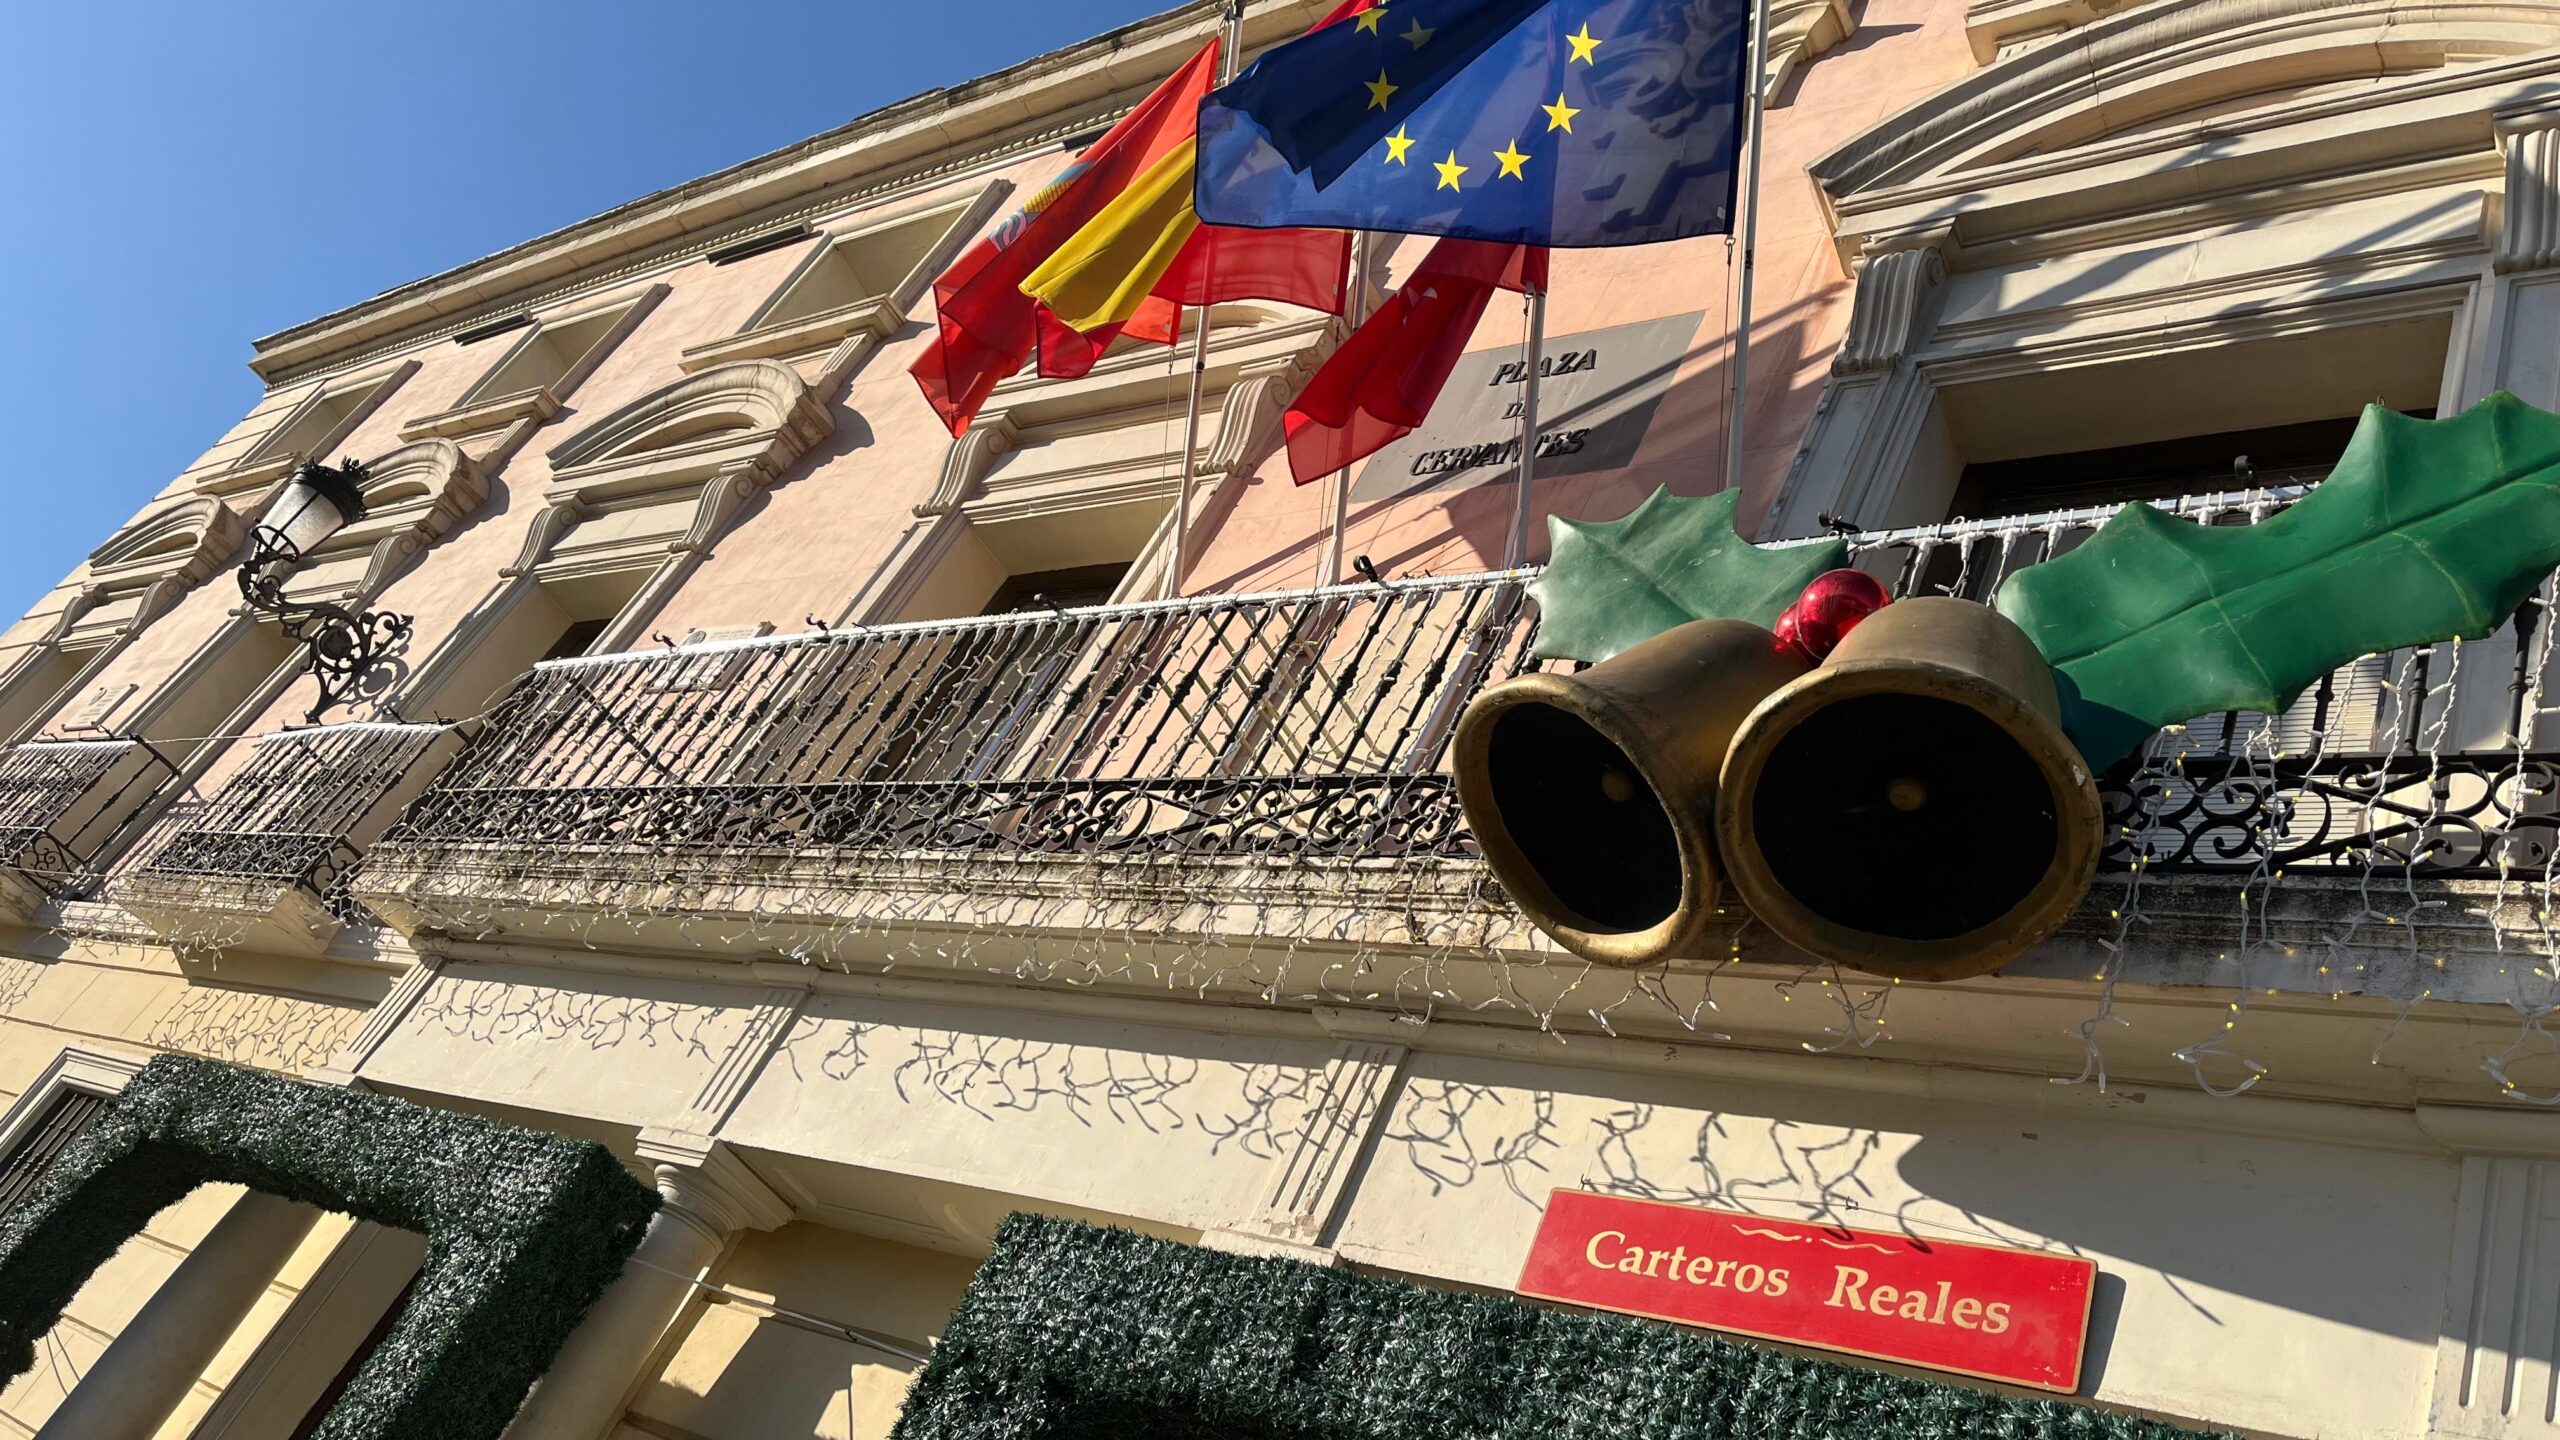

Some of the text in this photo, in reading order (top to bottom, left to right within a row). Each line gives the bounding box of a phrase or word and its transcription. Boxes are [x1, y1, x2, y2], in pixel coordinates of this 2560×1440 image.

[1488, 348, 1597, 386] PLAZA
[1501, 399, 1540, 420] D
[1585, 1230, 2012, 1335] Carteros Reales
